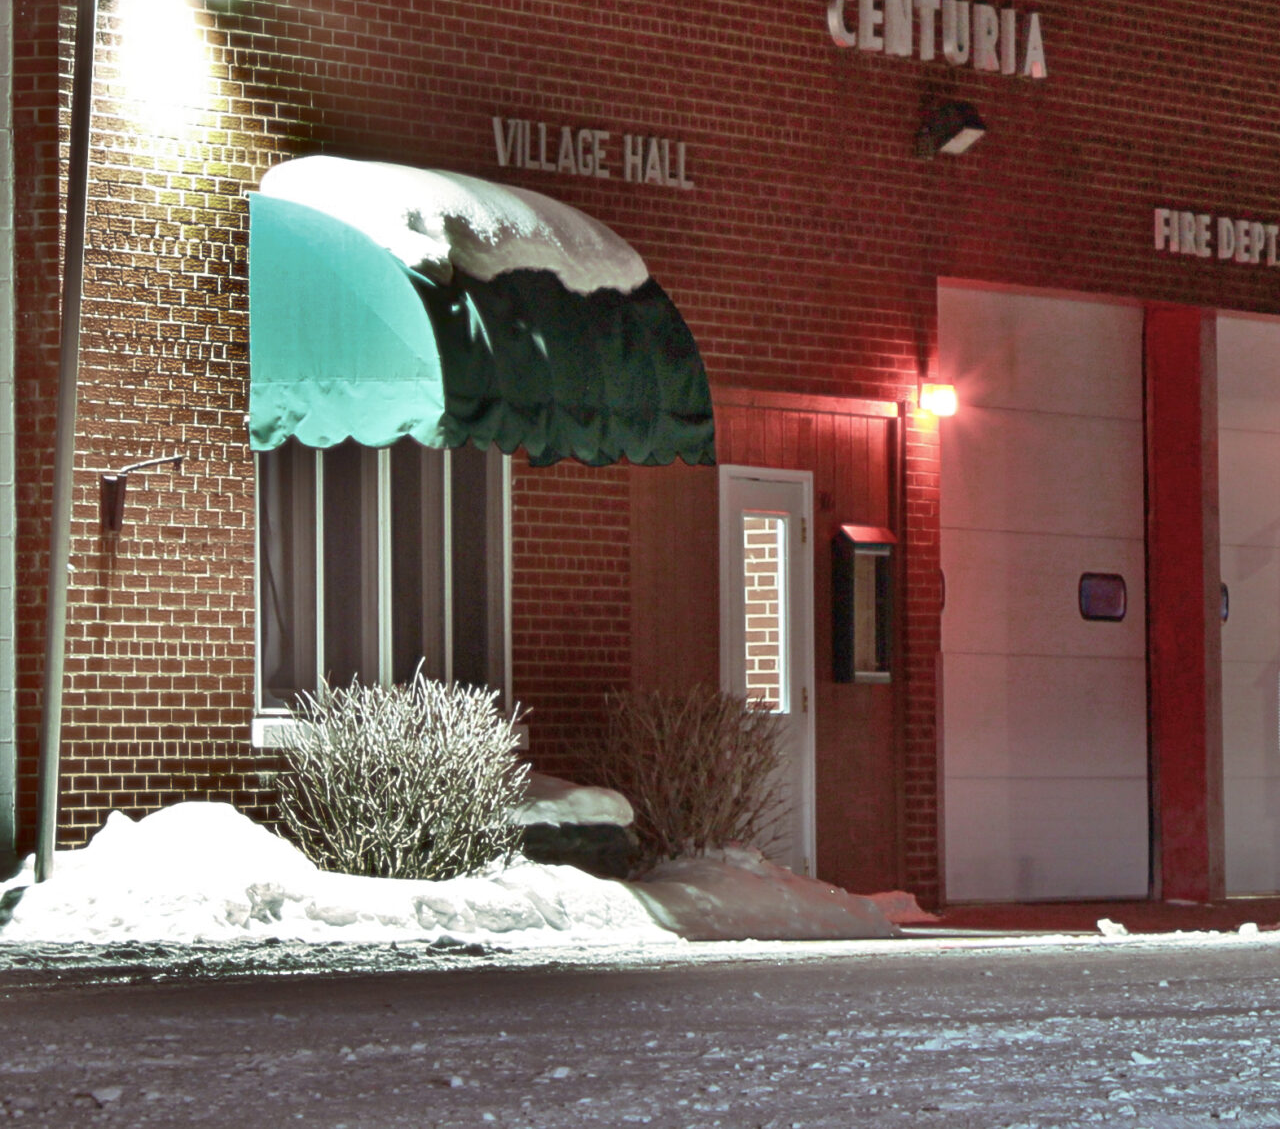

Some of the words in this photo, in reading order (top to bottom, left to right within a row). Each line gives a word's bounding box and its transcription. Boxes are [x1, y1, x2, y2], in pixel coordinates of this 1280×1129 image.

[493, 117, 610, 179] VILLAGE
[624, 134, 694, 190] HALL
[1154, 208, 1212, 258] FIRE
